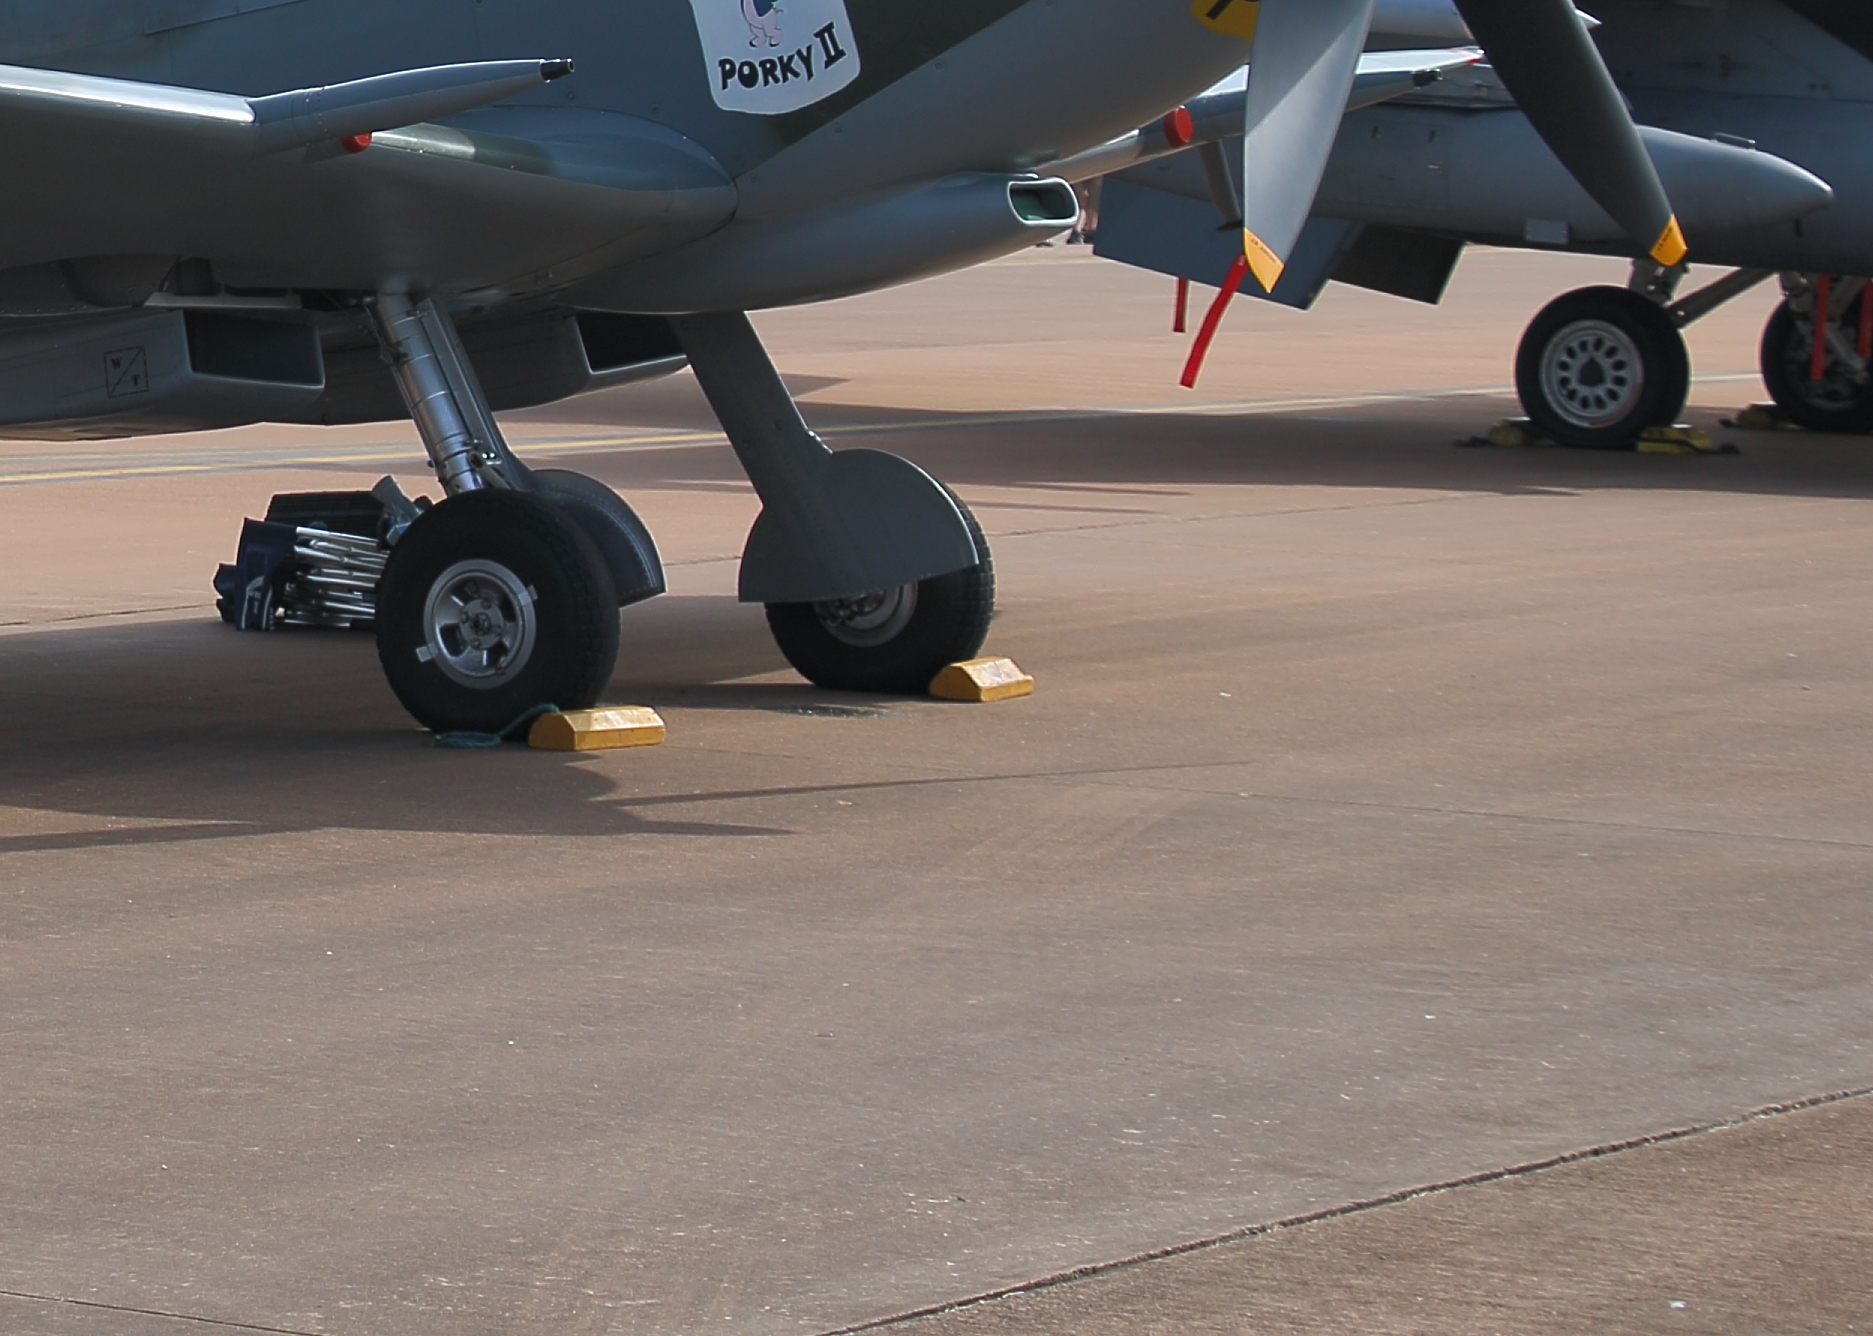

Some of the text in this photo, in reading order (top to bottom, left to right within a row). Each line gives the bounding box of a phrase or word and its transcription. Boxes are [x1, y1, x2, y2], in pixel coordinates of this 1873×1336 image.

[718, 21, 846, 90] PORKY II
[111, 356, 123, 369] W
[131, 373, 141, 386] T
